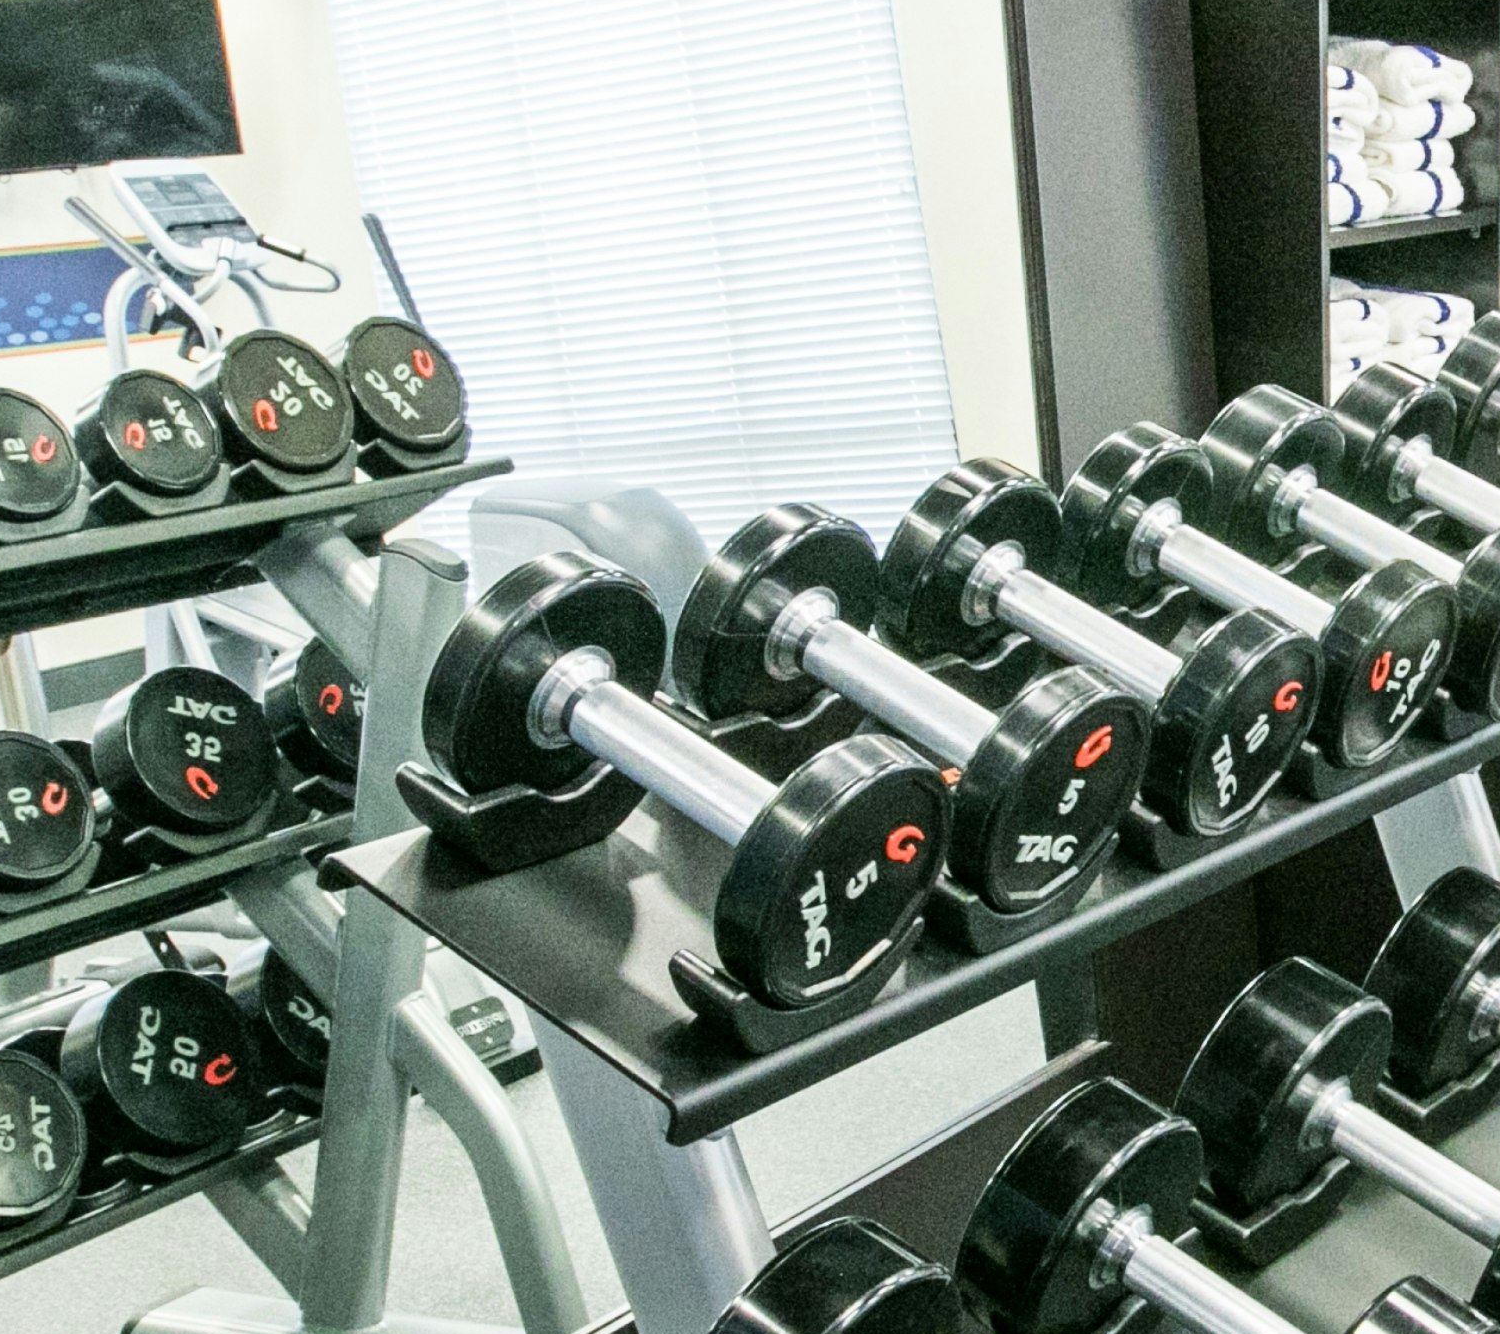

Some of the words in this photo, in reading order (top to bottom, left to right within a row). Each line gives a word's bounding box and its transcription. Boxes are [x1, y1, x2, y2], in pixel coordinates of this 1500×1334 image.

[1385, 657, 1411, 692] 10
[1389, 639, 1441, 724] TAG
[1244, 713, 1271, 753] 10
[1211, 734, 1238, 808] TAG
[1058, 779, 1086, 815] 5
[1015, 835, 1078, 863] TAG
[846, 860, 878, 899] 5
[800, 870, 831, 970] TAG
